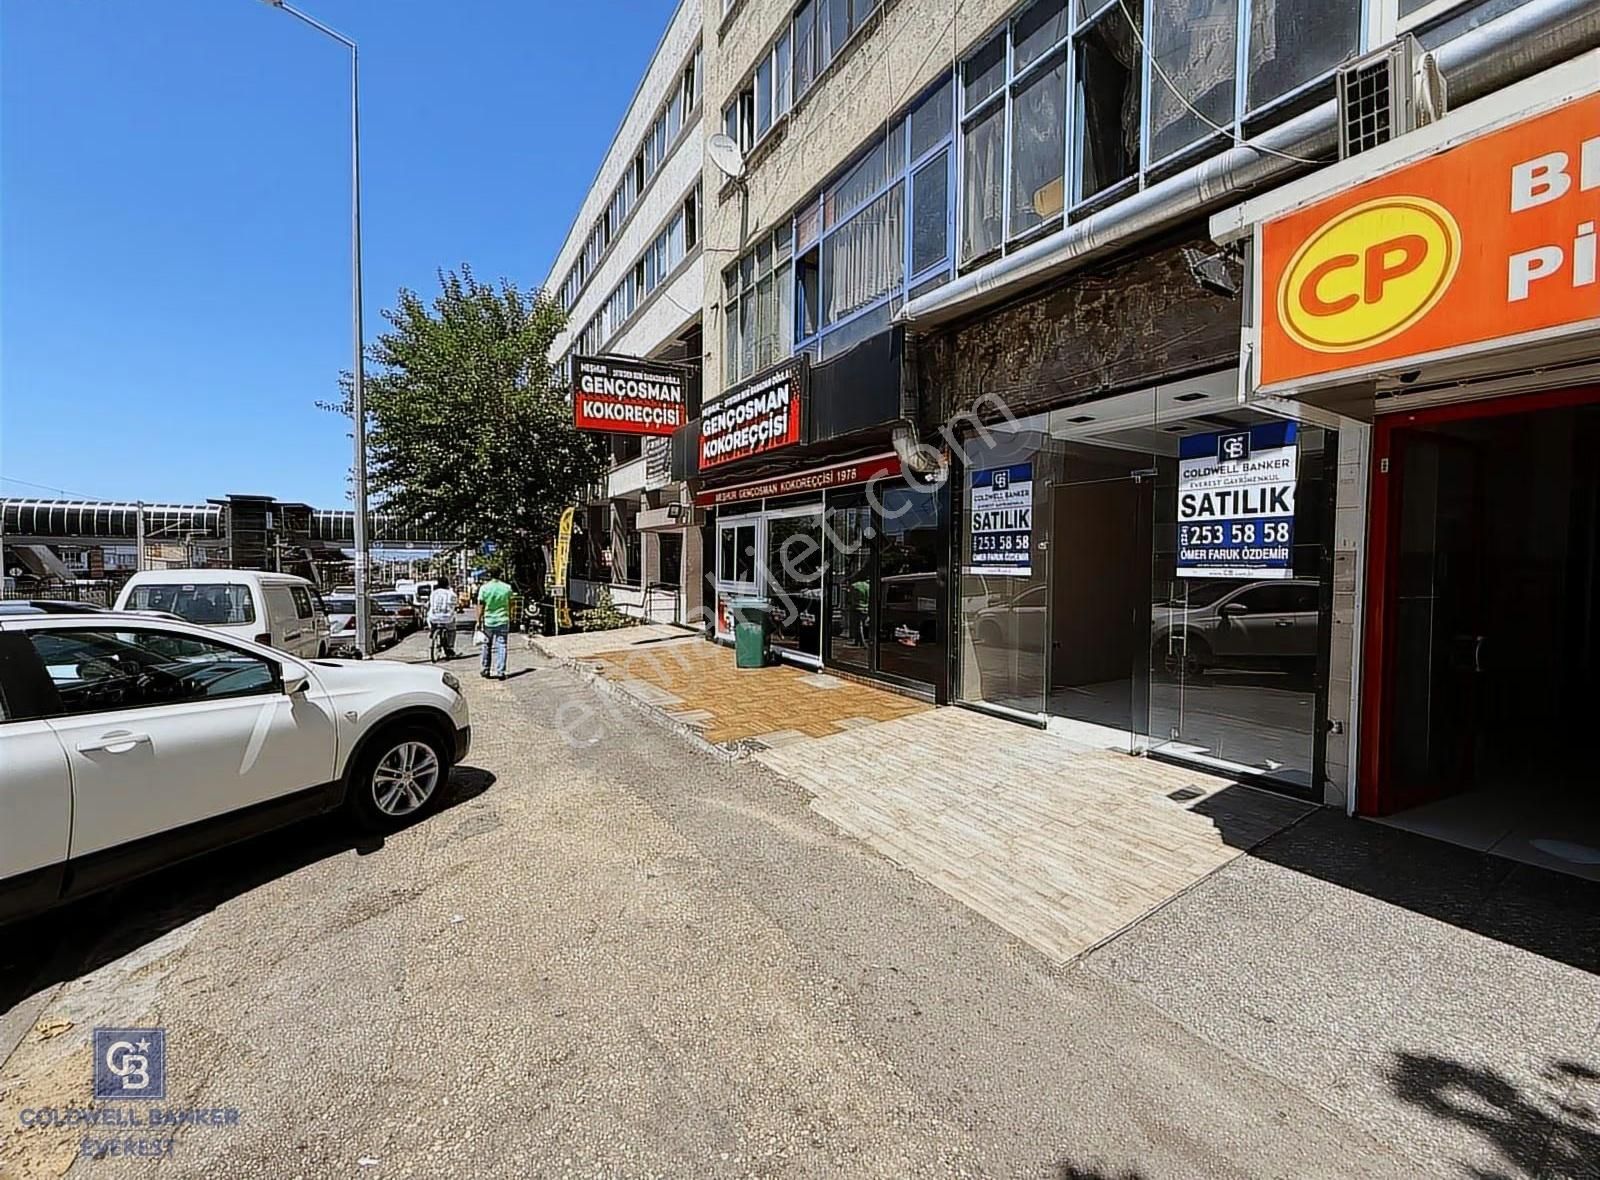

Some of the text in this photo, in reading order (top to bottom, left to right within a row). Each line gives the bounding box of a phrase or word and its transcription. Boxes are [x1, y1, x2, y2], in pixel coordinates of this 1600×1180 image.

[1299, 234, 1429, 317] CP
[581, 375, 681, 403] GENÇOSMAN
[583, 400, 680, 428] KOKOREÇÇİSİ
[702, 384, 789, 437] GENÇOSMAN
[703, 406, 788, 460] KOKOREÇÇİSİ
[1183, 458, 1290, 479] COLDWELL BANKER
[738, 482, 778, 499] GENÇOSMAN
[780, 471, 834, 491] KOKOREÇÇİSİ
[1180, 486, 1291, 518] SATILIK
[973, 508, 1030, 531] SATILIK
[1190, 525, 1224, 545] 253
[1231, 524, 1255, 544] 58
[1263, 522, 1289, 543] 58
[978, 536, 996, 550] 253
[1000, 535, 1012, 550] 58
[1016, 535, 1029, 550] 58
[1180, 545, 1289, 561] ÖMER FARUK ÖZDEMİR
